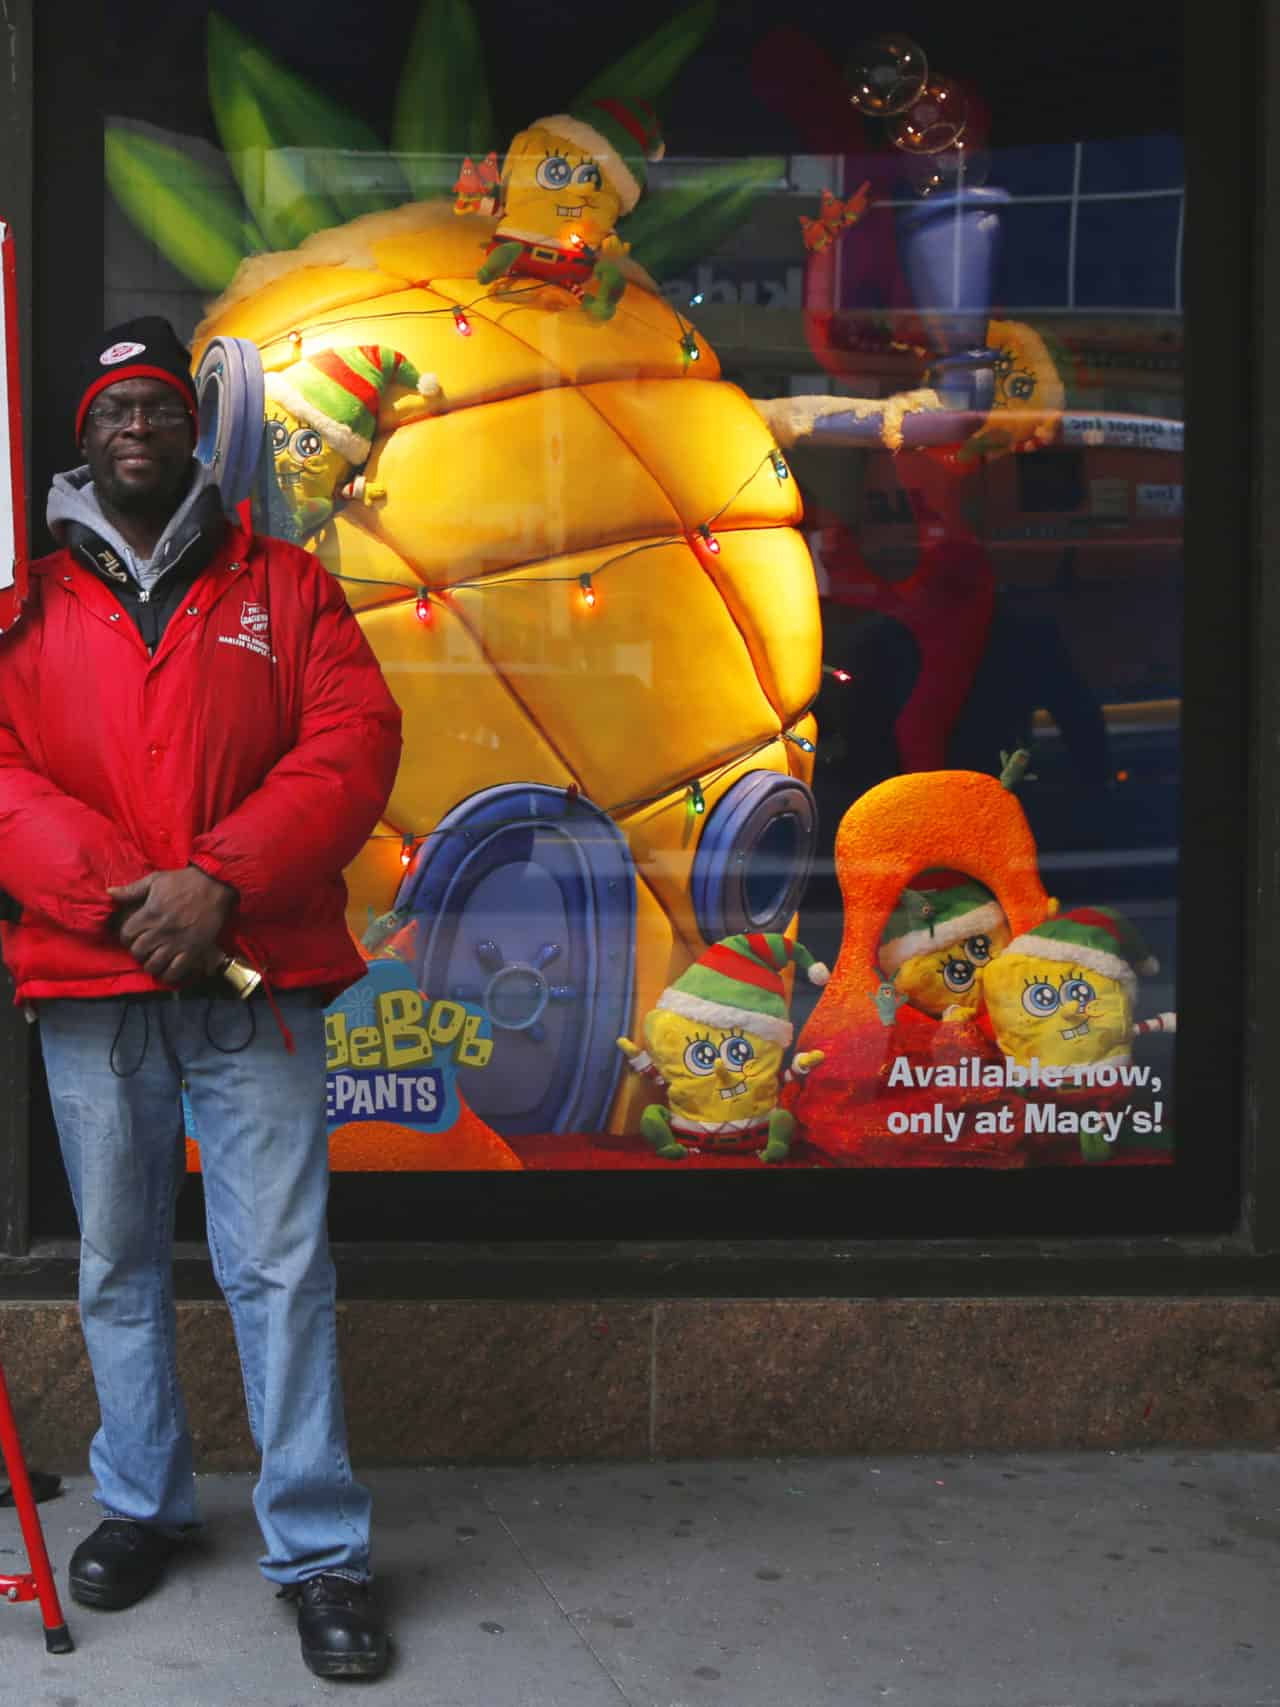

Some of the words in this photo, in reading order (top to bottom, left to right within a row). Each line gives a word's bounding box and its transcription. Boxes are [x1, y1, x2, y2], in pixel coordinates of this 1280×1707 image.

[887, 1055, 1064, 1088] Available
[1073, 1064, 1162, 1093] now,
[886, 1103, 966, 1143] only
[974, 1105, 1016, 1134] at
[1023, 1101, 1164, 1143] Macy's!
